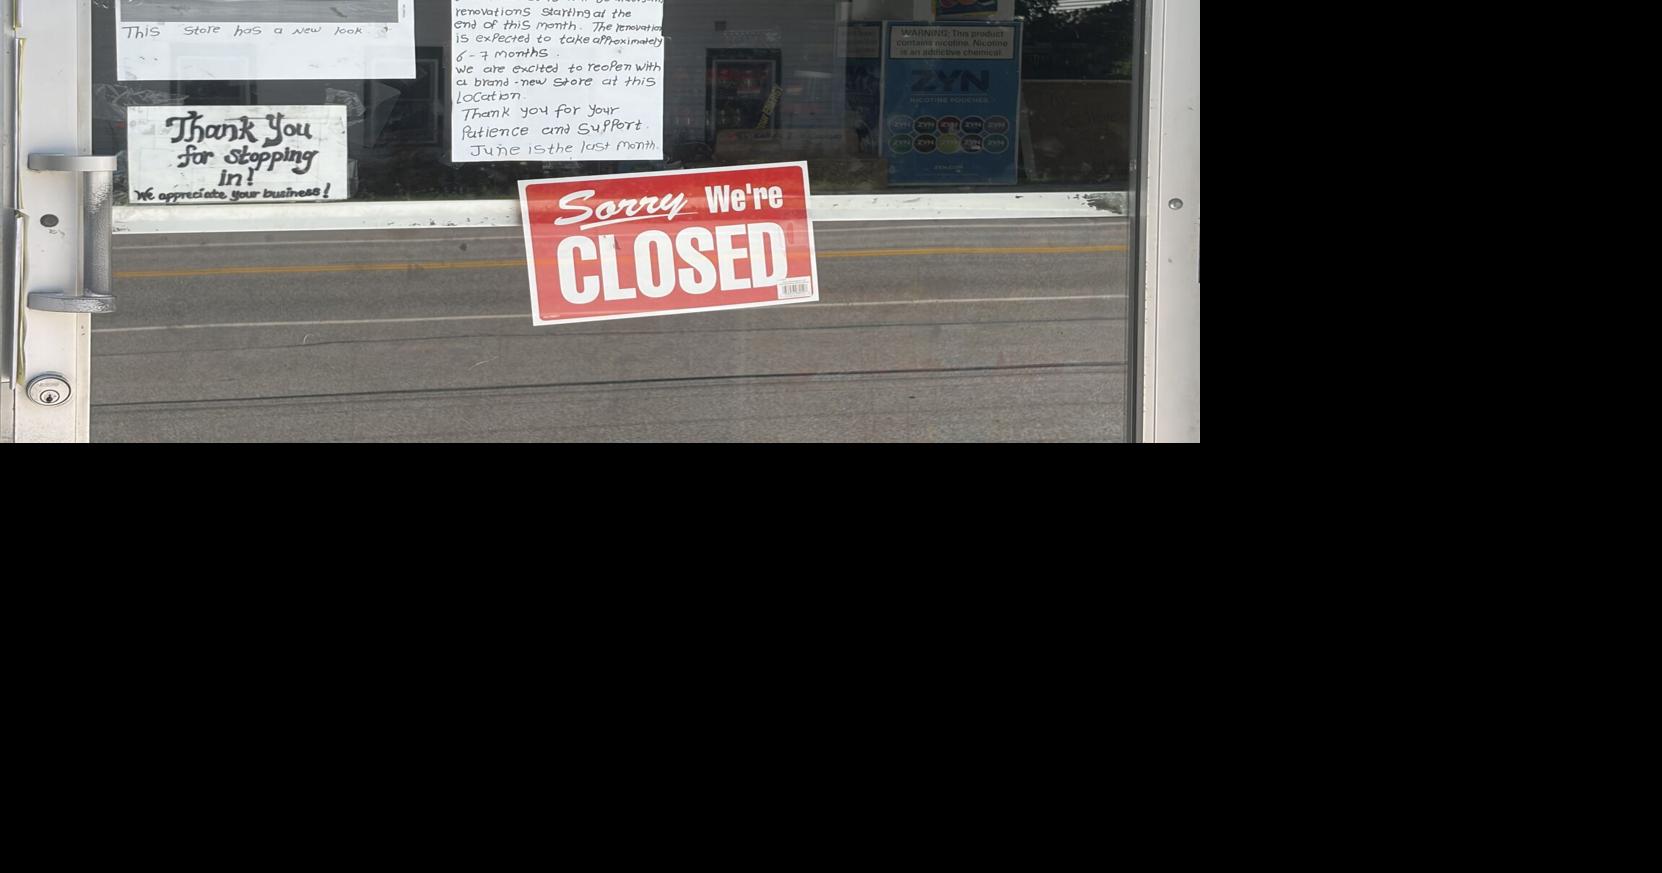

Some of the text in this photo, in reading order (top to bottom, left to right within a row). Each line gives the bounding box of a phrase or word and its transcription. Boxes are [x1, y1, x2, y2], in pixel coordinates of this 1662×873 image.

[593, 9, 606, 18] at
[612, 9, 632, 18] the
[122, 26, 160, 39] This
[233, 24, 262, 37] has
[274, 27, 283, 35] a
[334, 26, 363, 36] look
[454, 20, 476, 30] end
[484, 20, 497, 29] of
[592, 21, 612, 32] The
[456, 33, 469, 43] is
[536, 34, 551, 43] to
[560, 35, 590, 44] take
[901, 29, 950, 37] WARNING:
[971, 30, 1004, 38] product
[896, 39, 933, 47] contains
[484, 65, 505, 73] are
[512, 64, 559, 73] excited
[568, 63, 583, 73] to
[456, 78, 468, 86] a
[602, 78, 617, 86] at
[911, 70, 989, 91] ZYN
[462, 107, 510, 121] Thank
[520, 106, 548, 118] you
[554, 104, 580, 119] for
[165, 111, 258, 143] Thank
[541, 124, 570, 135] and
[550, 143, 573, 153] the
[581, 141, 611, 151] last
[177, 144, 319, 175] for stopping
[218, 168, 255, 187] in!
[134, 189, 155, 201] We
[158, 190, 227, 202] appreciate
[229, 190, 260, 201] your
[554, 183, 783, 226] Sorry We're
[556, 222, 788, 304] CLOSED
